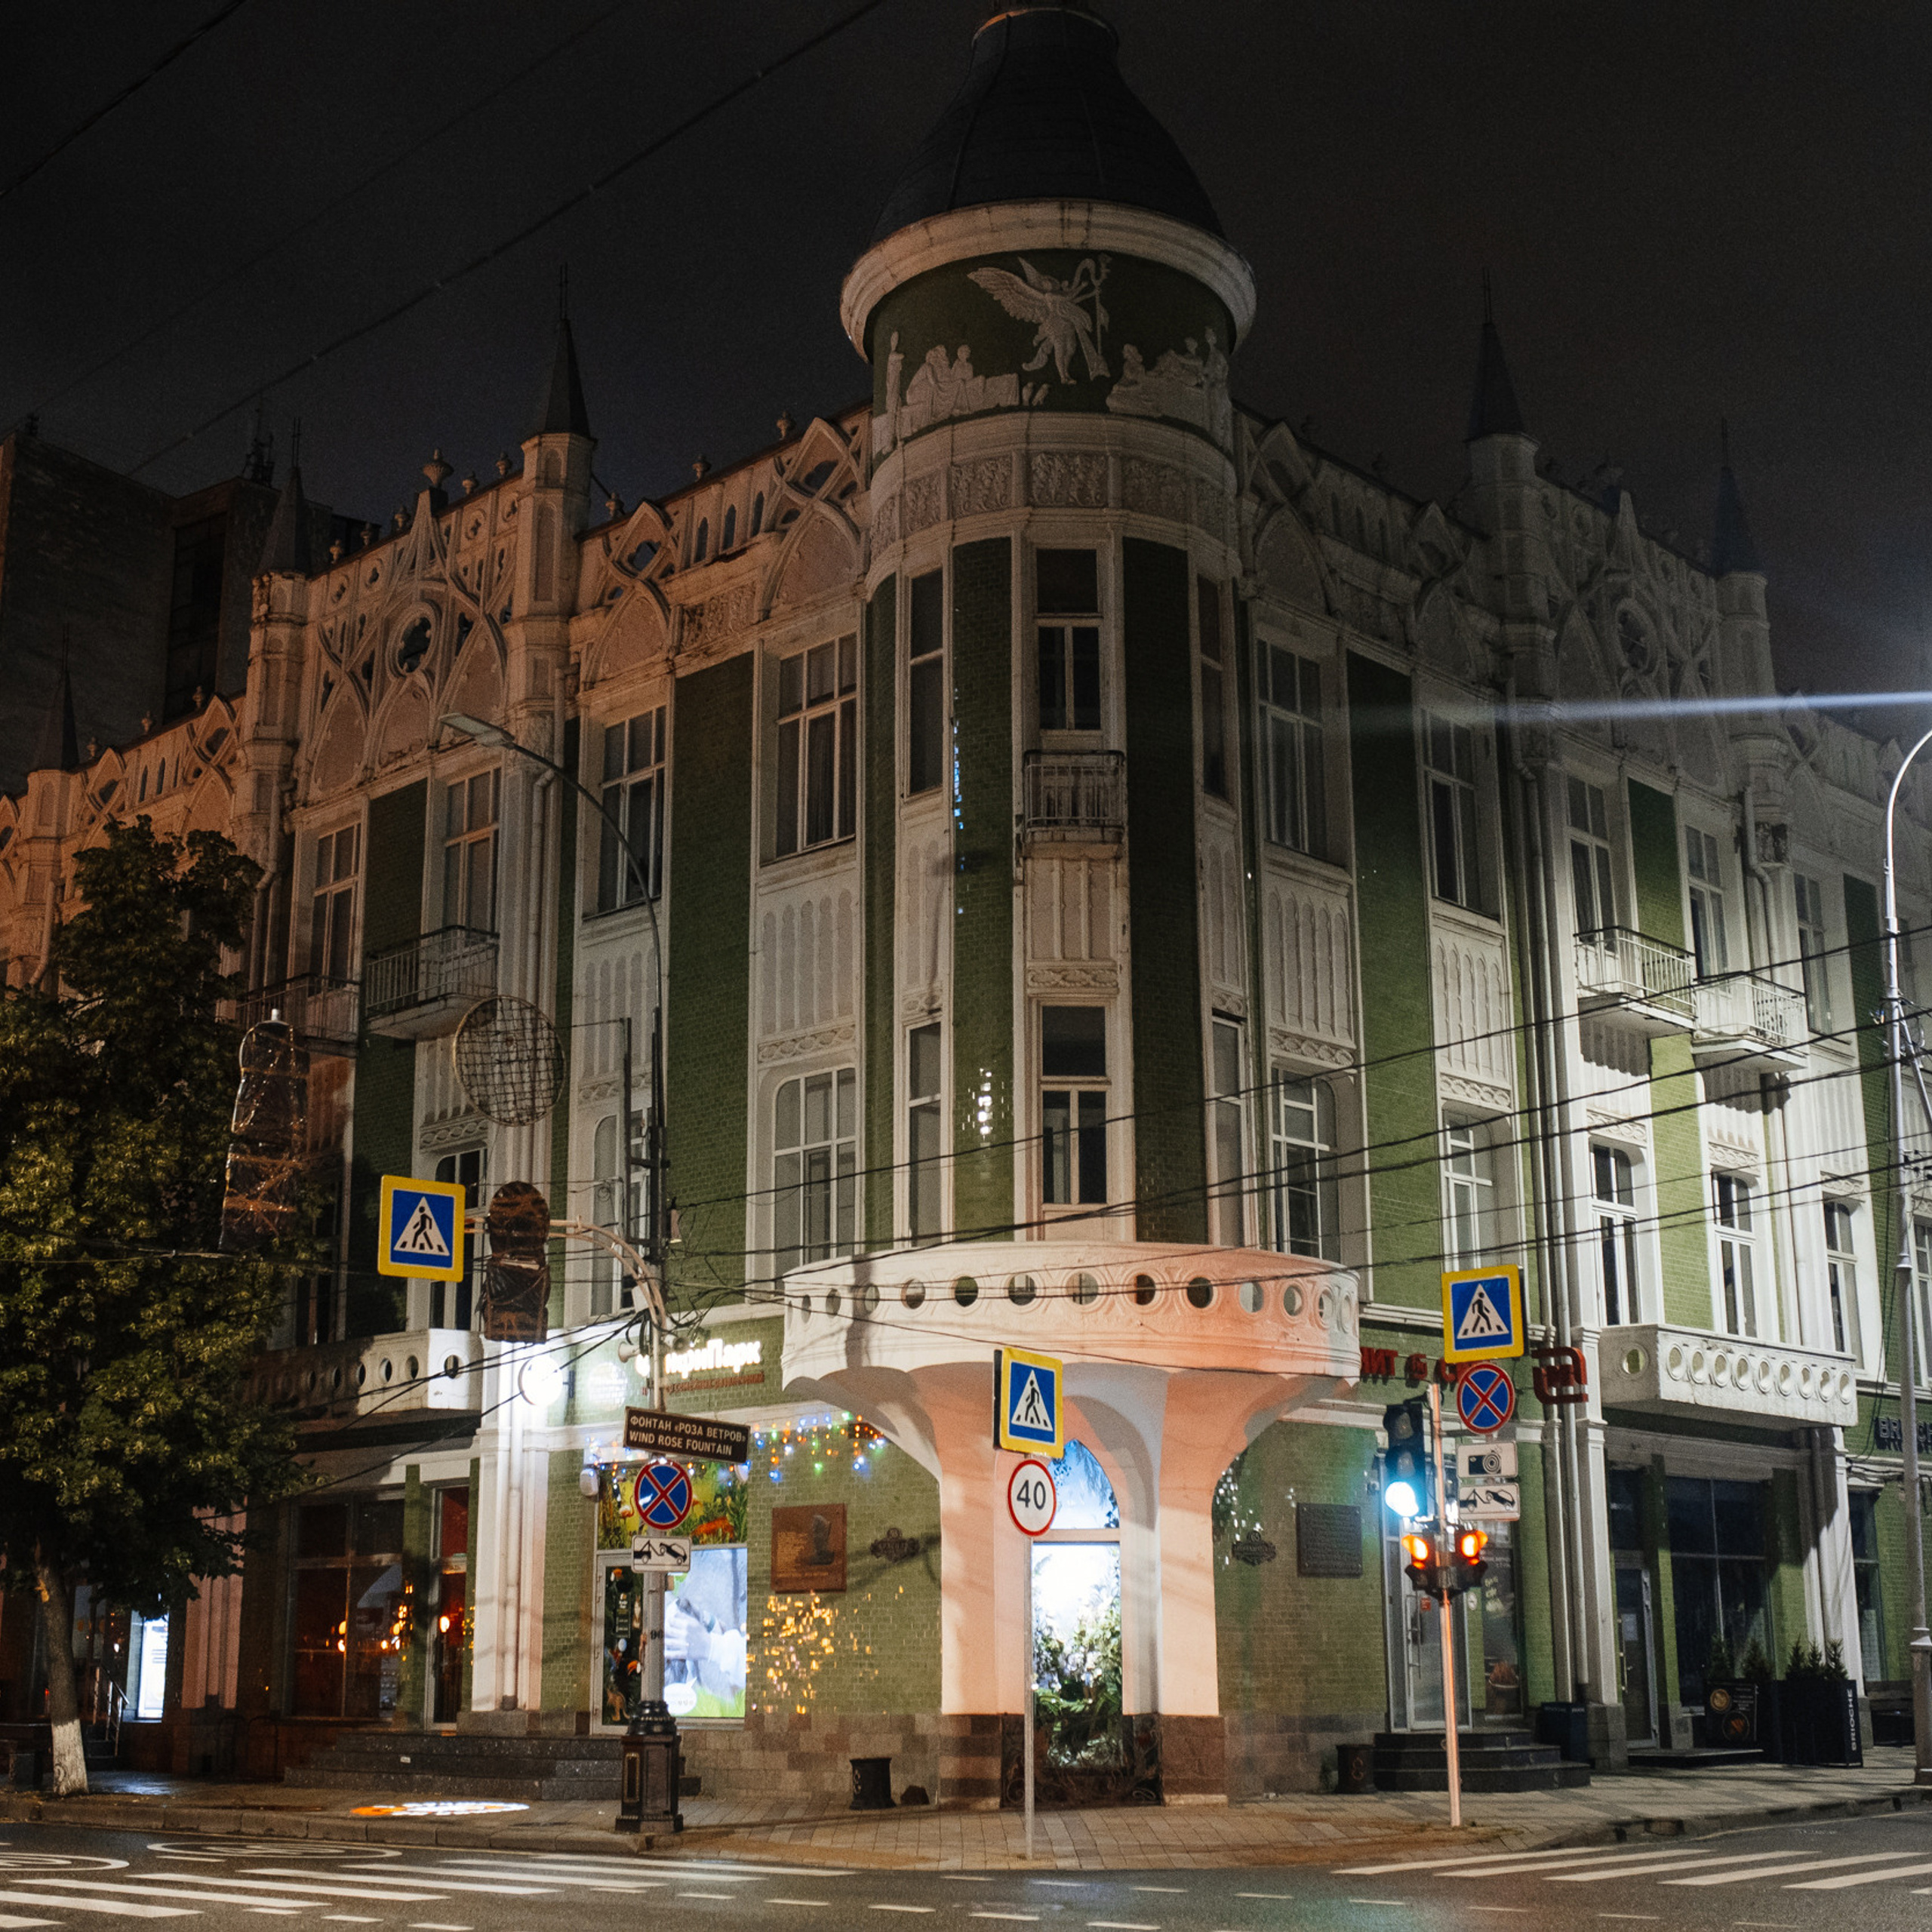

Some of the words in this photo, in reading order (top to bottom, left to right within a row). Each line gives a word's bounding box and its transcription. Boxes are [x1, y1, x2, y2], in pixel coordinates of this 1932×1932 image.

[630, 1416, 672, 1432] ФОНТАН
[675, 1422, 703, 1436] «РОЗА
[707, 1427, 746, 1442] ВЕТРОВ»
[629, 1431, 655, 1444] WIND
[658, 1436, 683, 1448] ROSE
[686, 1439, 732, 1456] FOUNTAIN
[1017, 1479, 1046, 1510] 40
[1847, 1689, 1857, 1751] BRIOCHE
